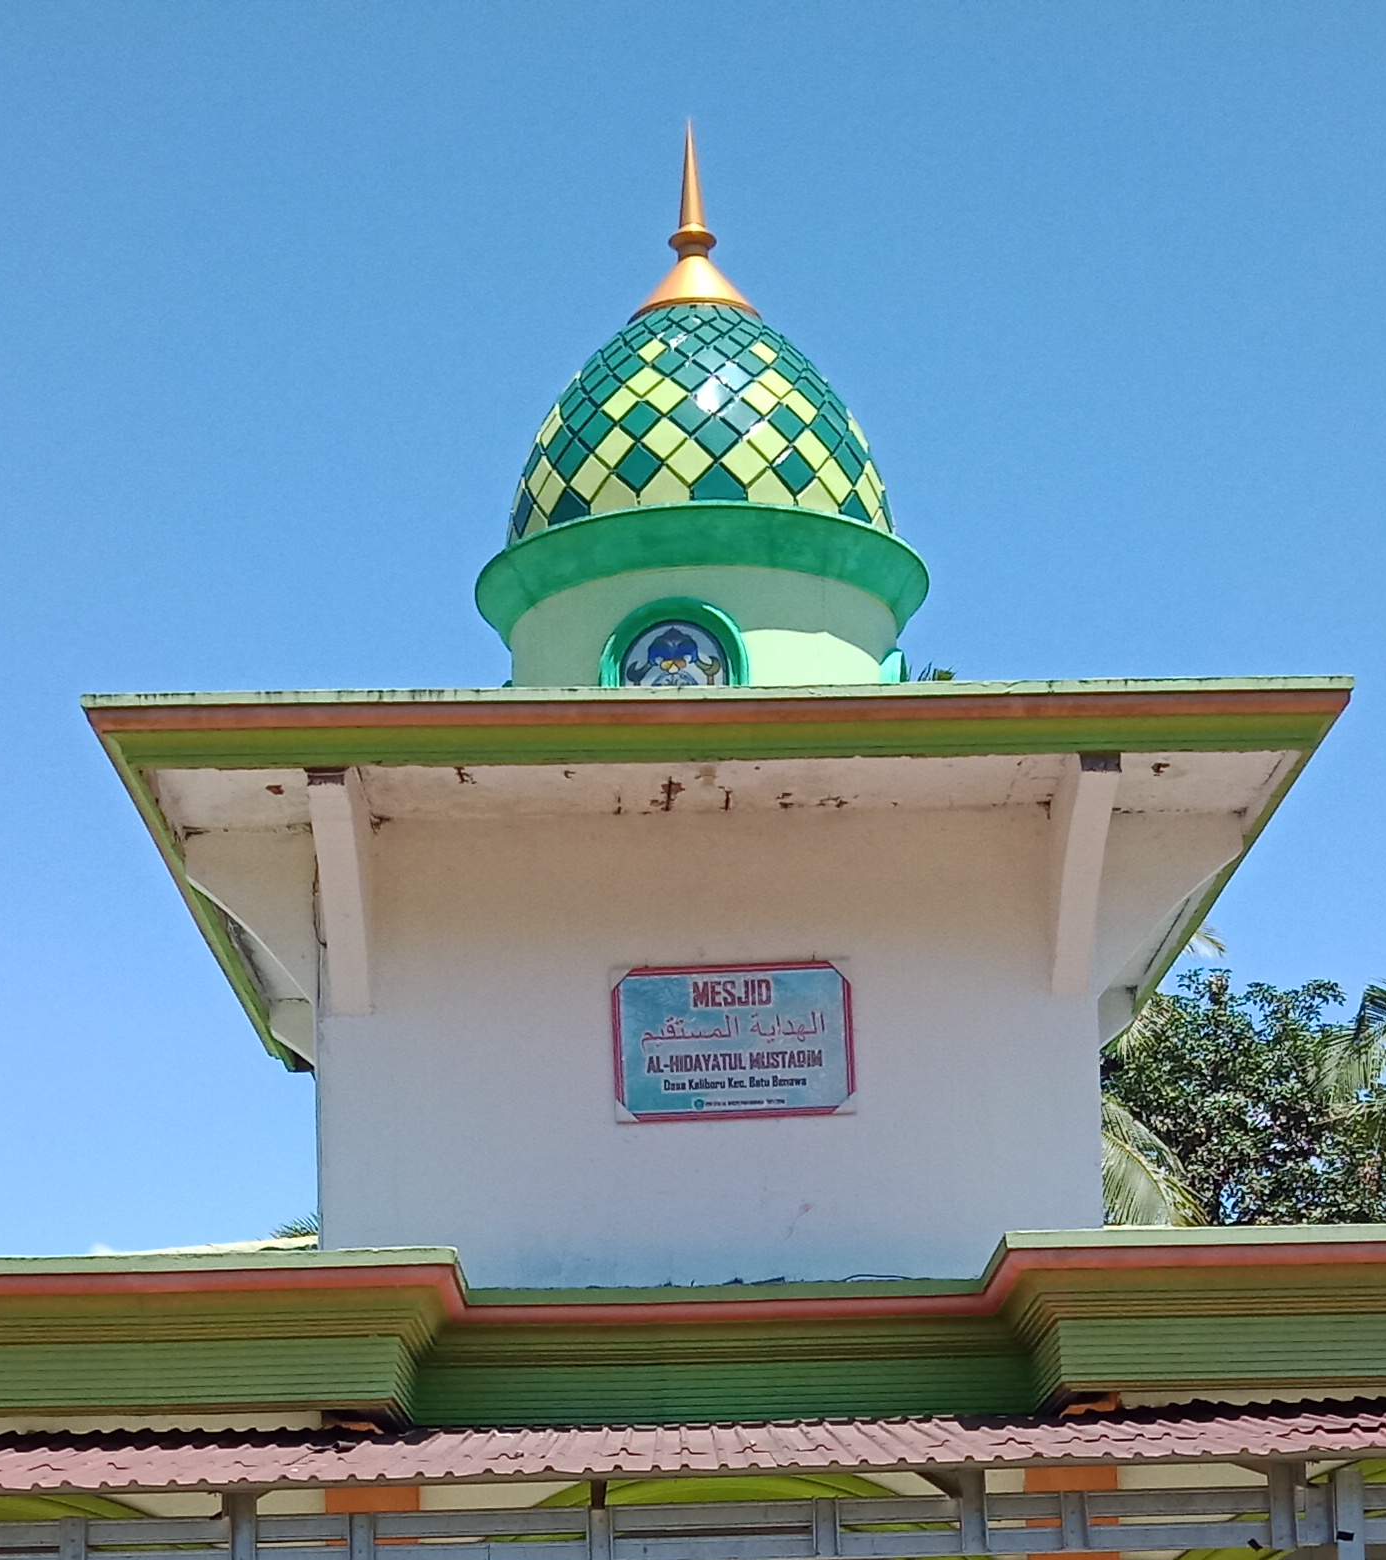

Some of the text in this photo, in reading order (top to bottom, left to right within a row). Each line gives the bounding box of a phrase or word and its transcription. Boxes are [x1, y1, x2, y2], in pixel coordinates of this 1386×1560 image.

[693, 979, 771, 1007] MESJID
[641, 1011, 825, 1052] الهداية المستقيم
[647, 1050, 823, 1073] AL-HIDAYATUL MUSTAQIM
[727, 1077, 747, 1088] Kec.
[749, 1076, 770, 1087] Batu
